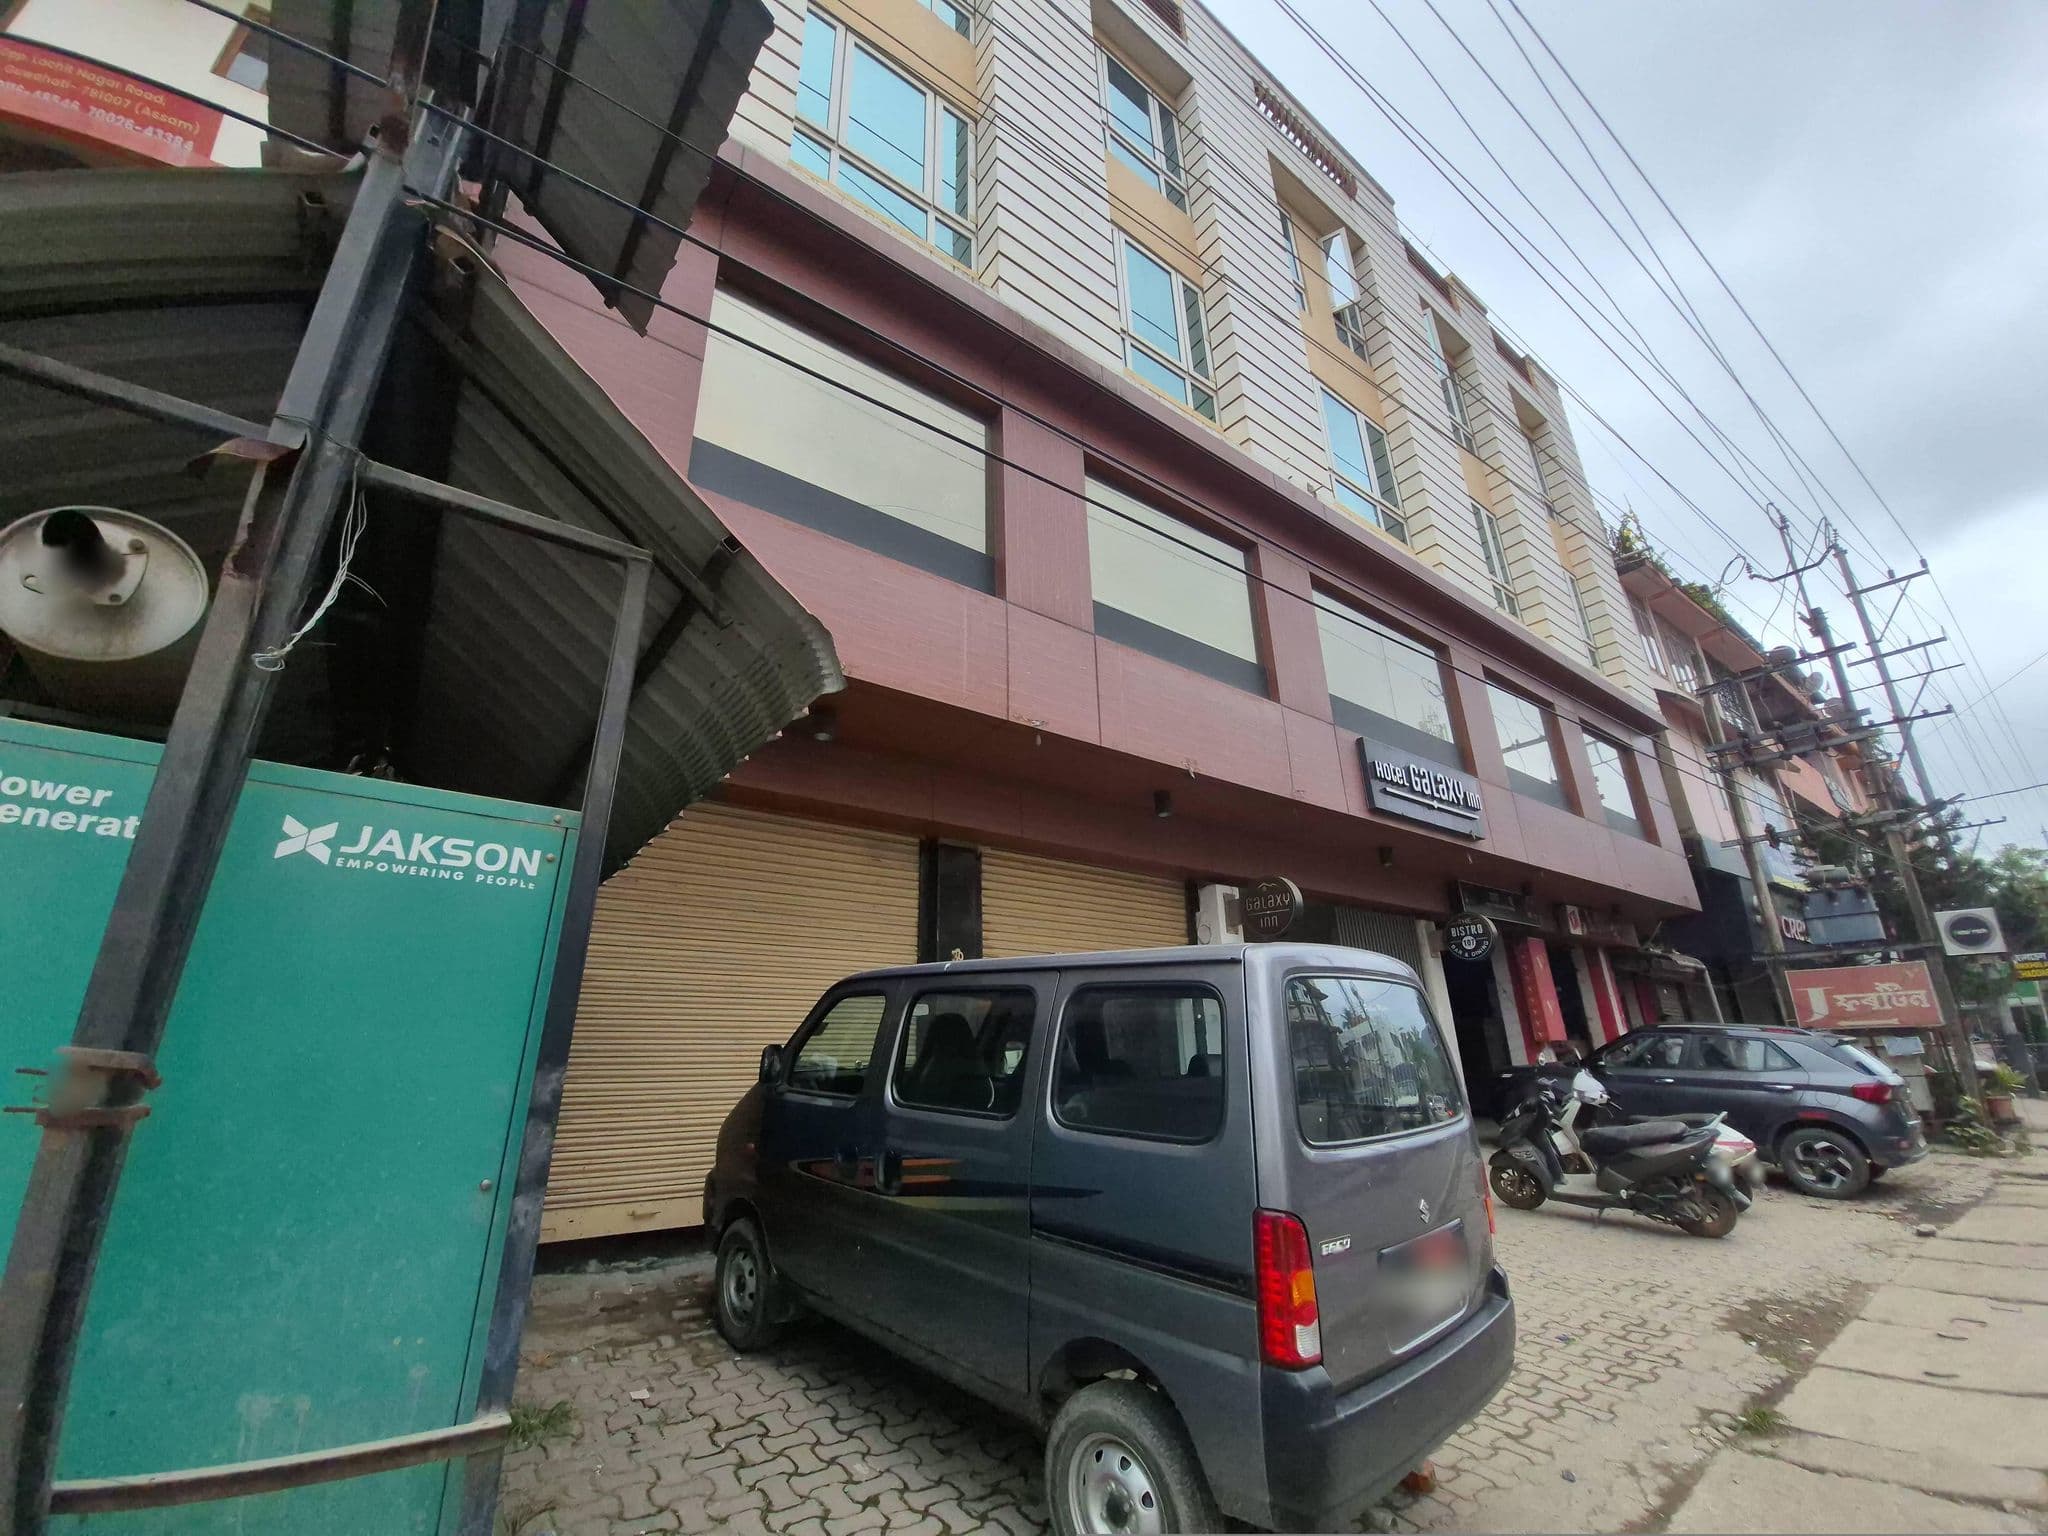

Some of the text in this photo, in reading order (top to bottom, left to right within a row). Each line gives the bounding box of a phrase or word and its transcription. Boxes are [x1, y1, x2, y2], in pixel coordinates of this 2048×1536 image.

[0, 769, 113, 808] ower
[0, 803, 140, 840] enerat
[339, 825, 542, 877] JAKSON
[335, 857, 536, 890] EMPOWERING PEOPLE
[1450, 923, 1483, 938] BISTRO
